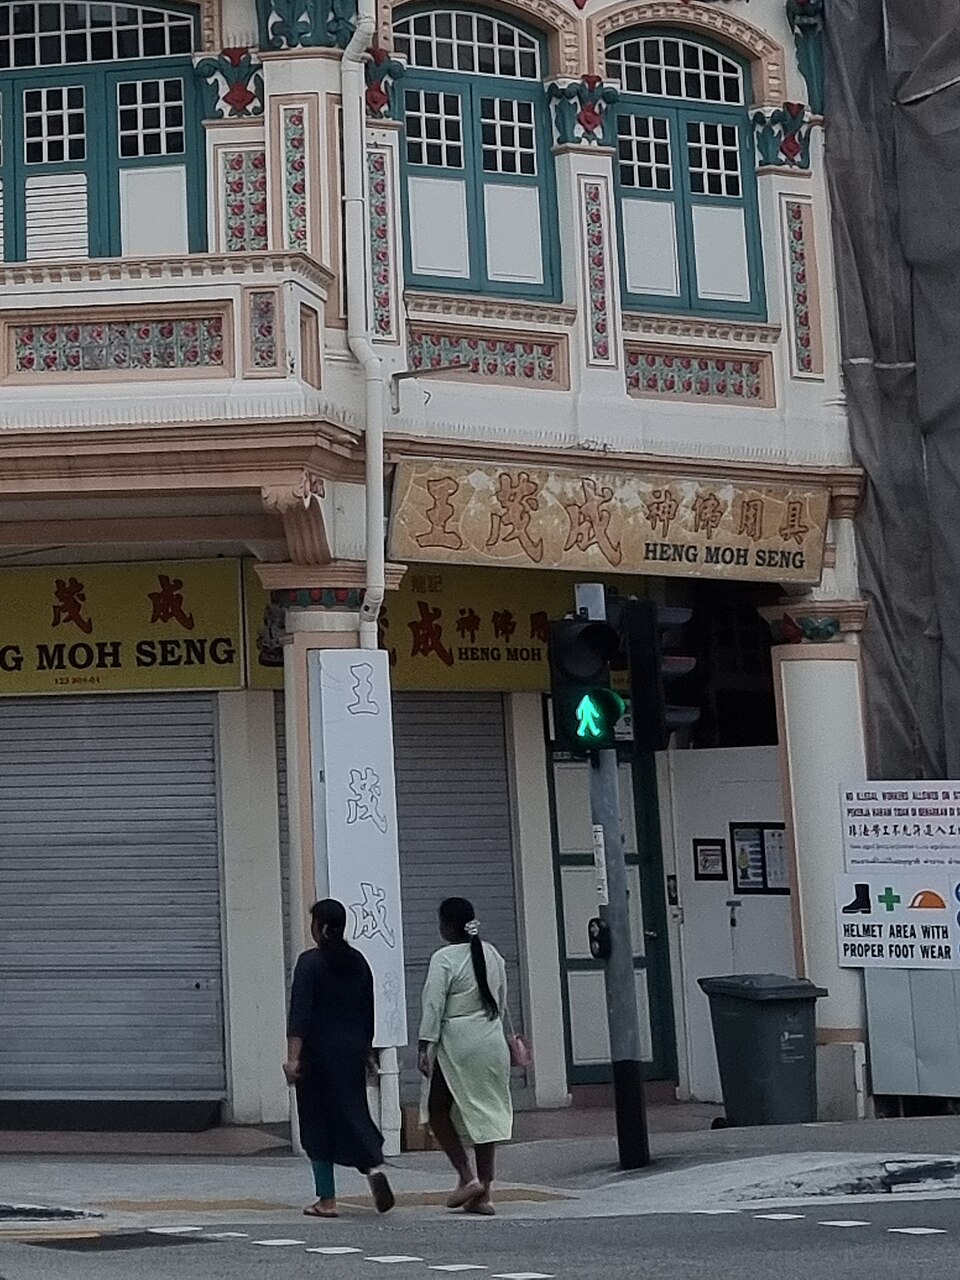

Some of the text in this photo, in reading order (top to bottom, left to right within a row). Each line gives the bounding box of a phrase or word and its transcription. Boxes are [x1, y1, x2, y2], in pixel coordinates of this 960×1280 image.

[644, 543, 806, 569] HENG MOH SENG
[36, 641, 122, 671] MOH
[135, 637, 236, 667] SENG
[458, 647, 542, 661] HENG MOH
[346, 661, 396, 948] 王茂成
[843, 923, 949, 940] HELMET AREA WITH
[843, 943, 952, 960] PROPER FOOT WEAR
